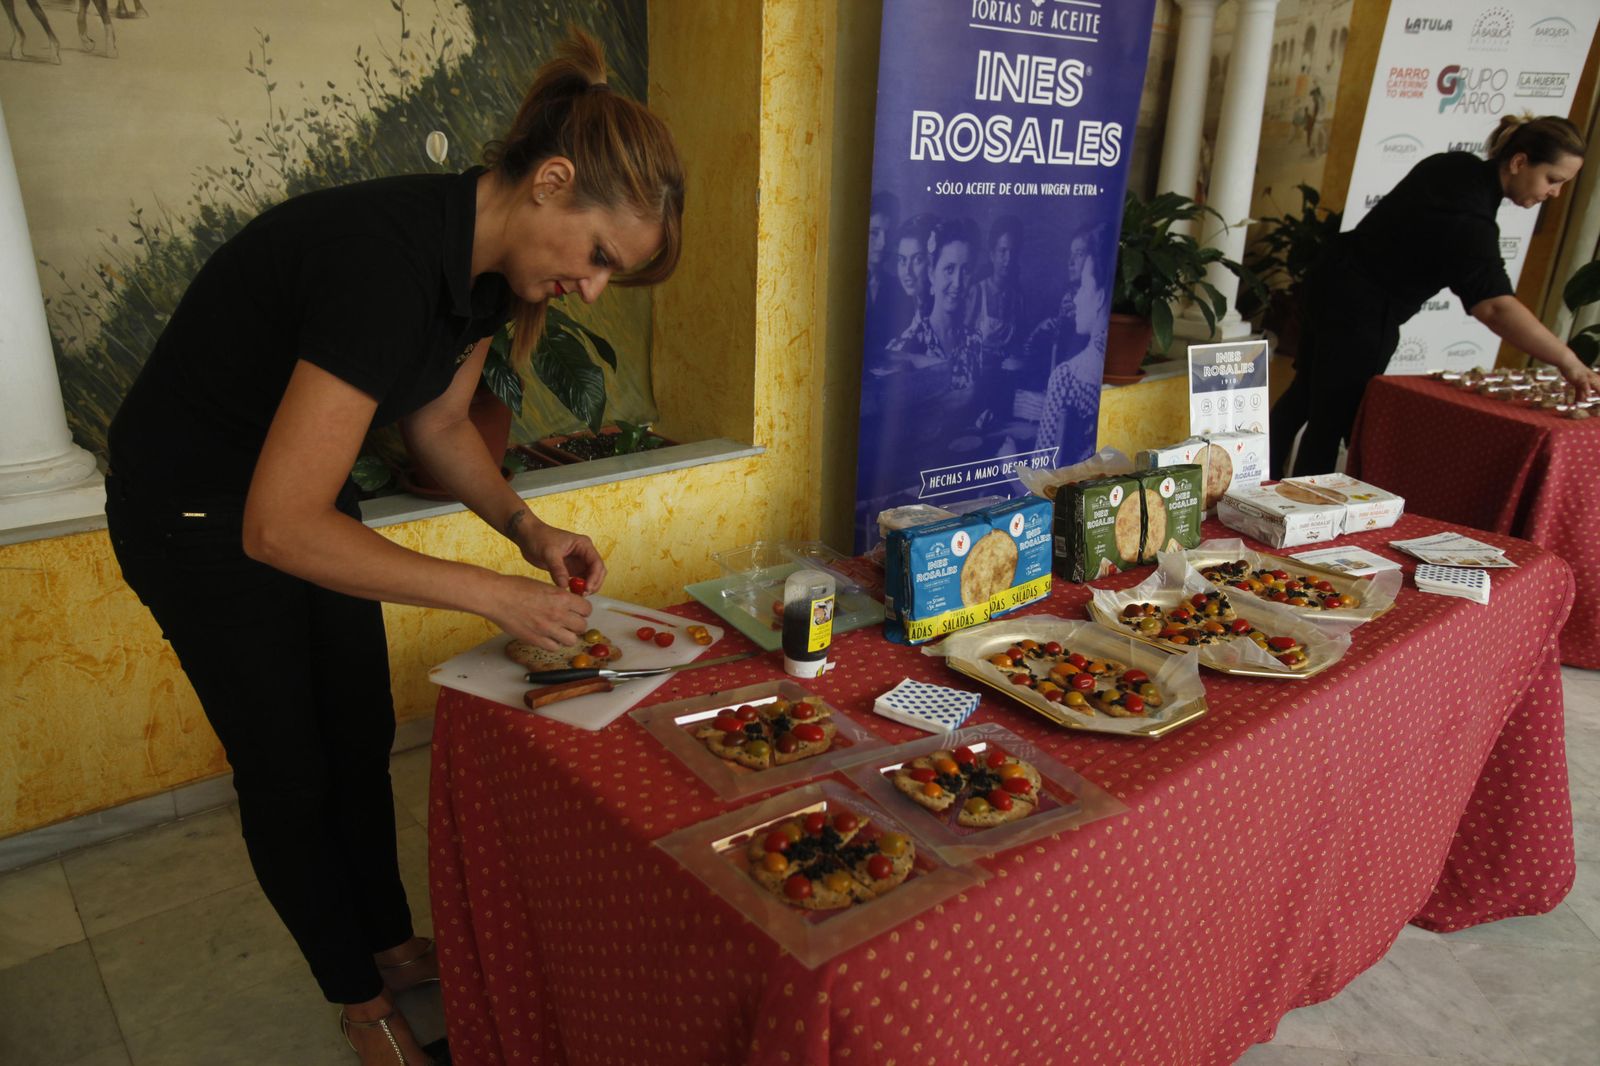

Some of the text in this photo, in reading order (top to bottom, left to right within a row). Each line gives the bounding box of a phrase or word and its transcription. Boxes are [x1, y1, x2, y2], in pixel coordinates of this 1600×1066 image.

[972, 0, 1101, 34] TORTAS DE ACEITE
[1405, 17, 1453, 31] LATULA
[975, 50, 1084, 107] INES
[1390, 67, 1429, 79] PARRO
[910, 110, 1122, 167] ROSALES
[935, 180, 1097, 196] SÓLO ACEITE DE OLIVA VIRGEN EXTRA
[1215, 351, 1241, 363] INES
[1203, 362, 1255, 378] ROSALES
[929, 474, 963, 489] HECHAS
[966, 471, 971, 481] A
[974, 465, 999, 480] MANO
[1032, 456, 1049, 469] 1910
[916, 565, 957, 582] ROSALES
[1012, 585, 1038, 605] SALADAS
[943, 613, 974, 632] SALADAS
